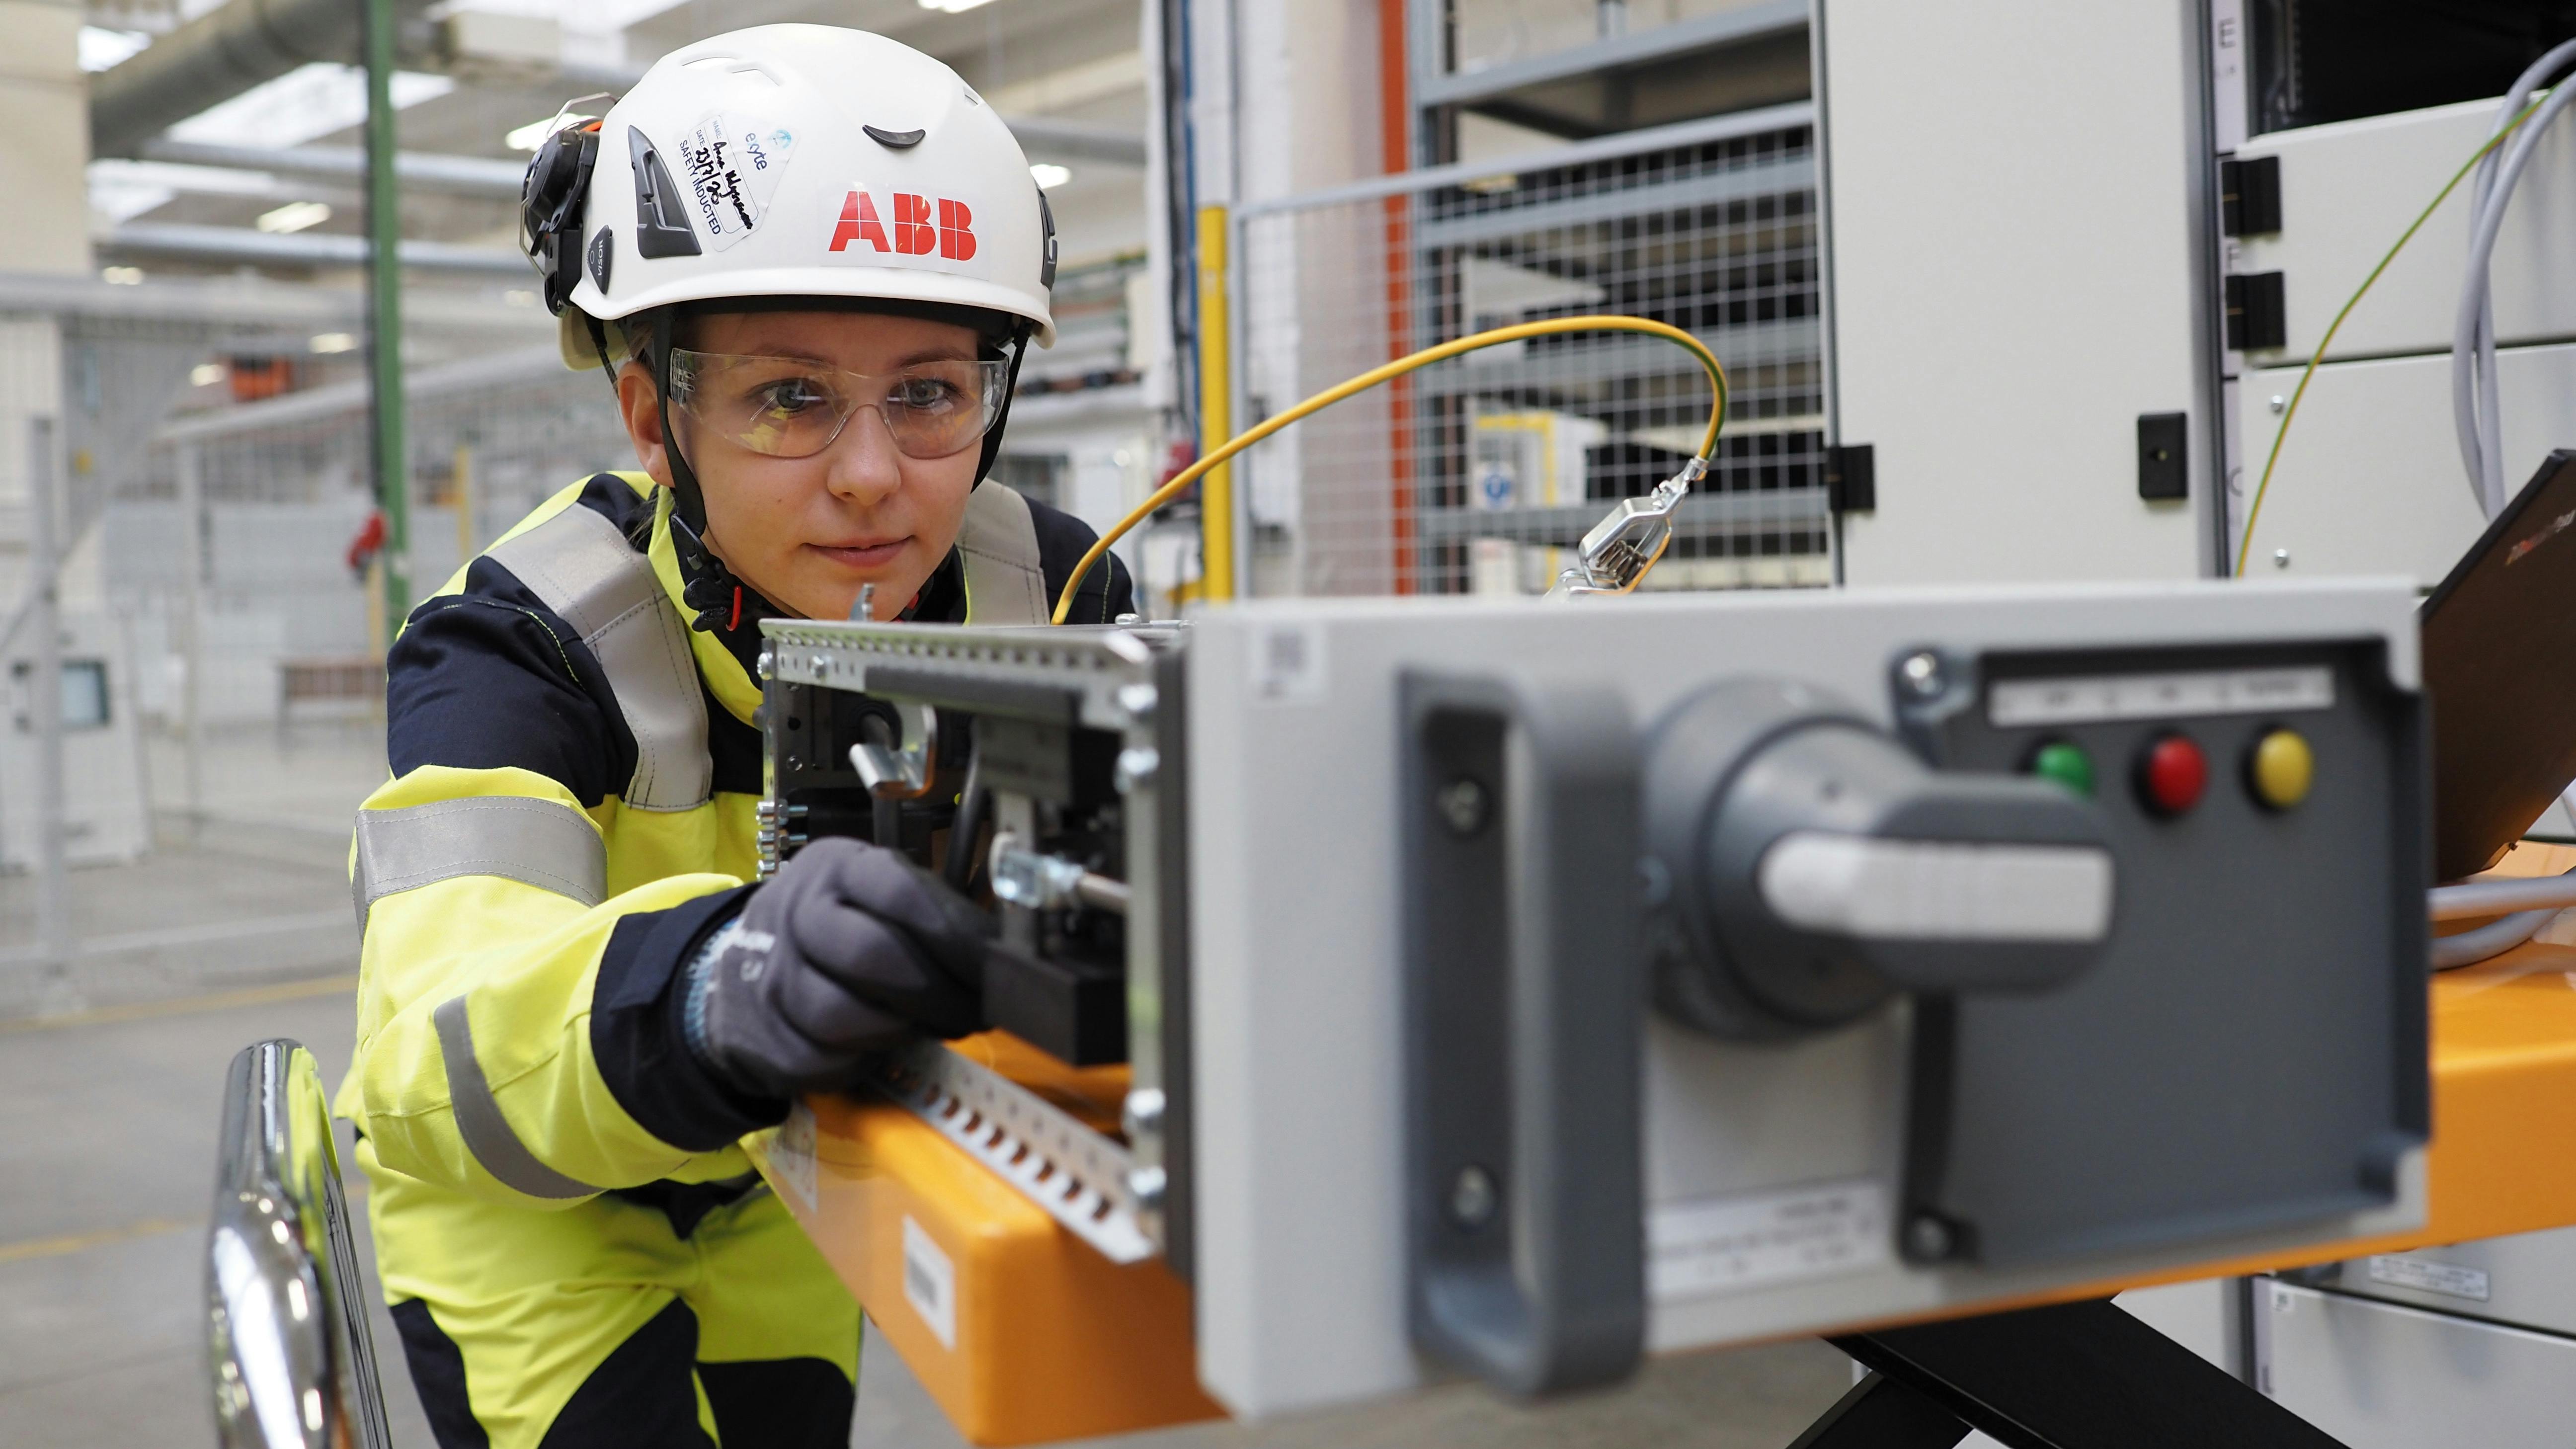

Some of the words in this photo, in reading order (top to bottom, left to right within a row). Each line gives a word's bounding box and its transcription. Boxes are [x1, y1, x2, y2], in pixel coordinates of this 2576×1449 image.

[696, 129, 705, 148] DATE:
[680, 140, 698, 176] SAFETY
[692, 177, 722, 235] INDUCTED
[828, 191, 977, 261] ABB
